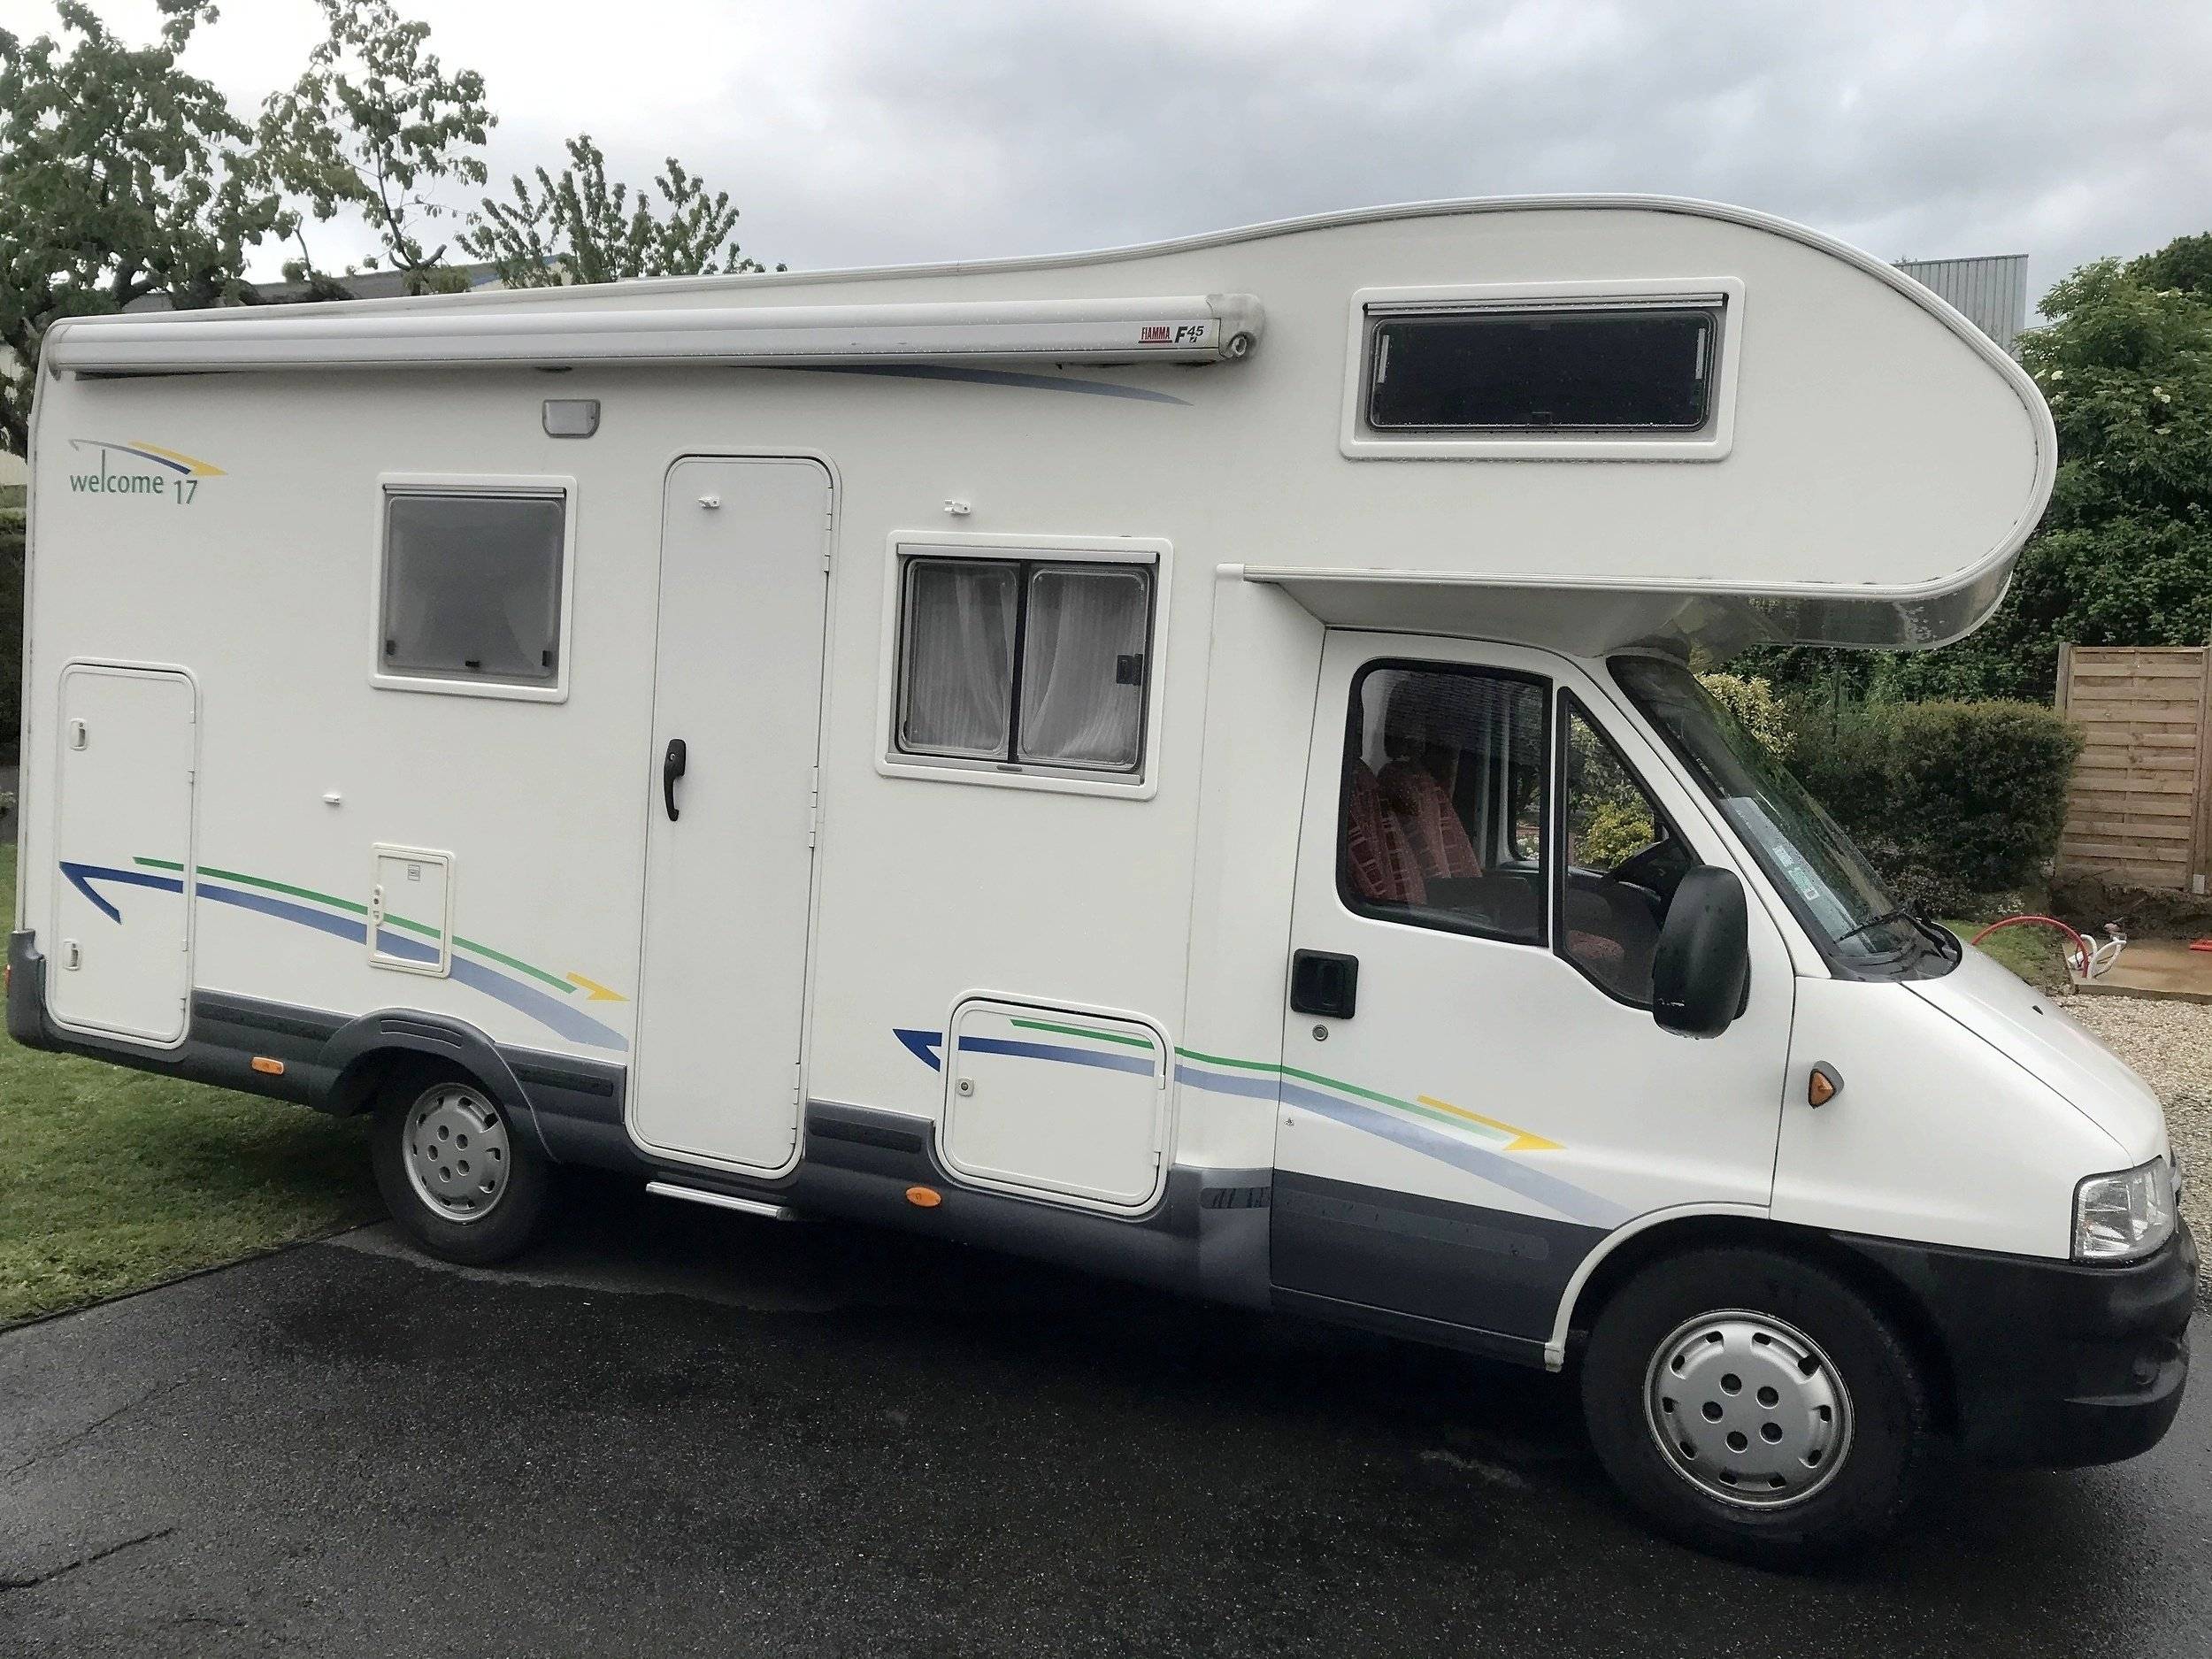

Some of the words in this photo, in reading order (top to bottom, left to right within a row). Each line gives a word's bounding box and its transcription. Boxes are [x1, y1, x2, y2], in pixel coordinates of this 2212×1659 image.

[1141, 326, 1171, 341] FIAMMA
[69, 449, 164, 494] welcome
[173, 480, 198, 505] 17
